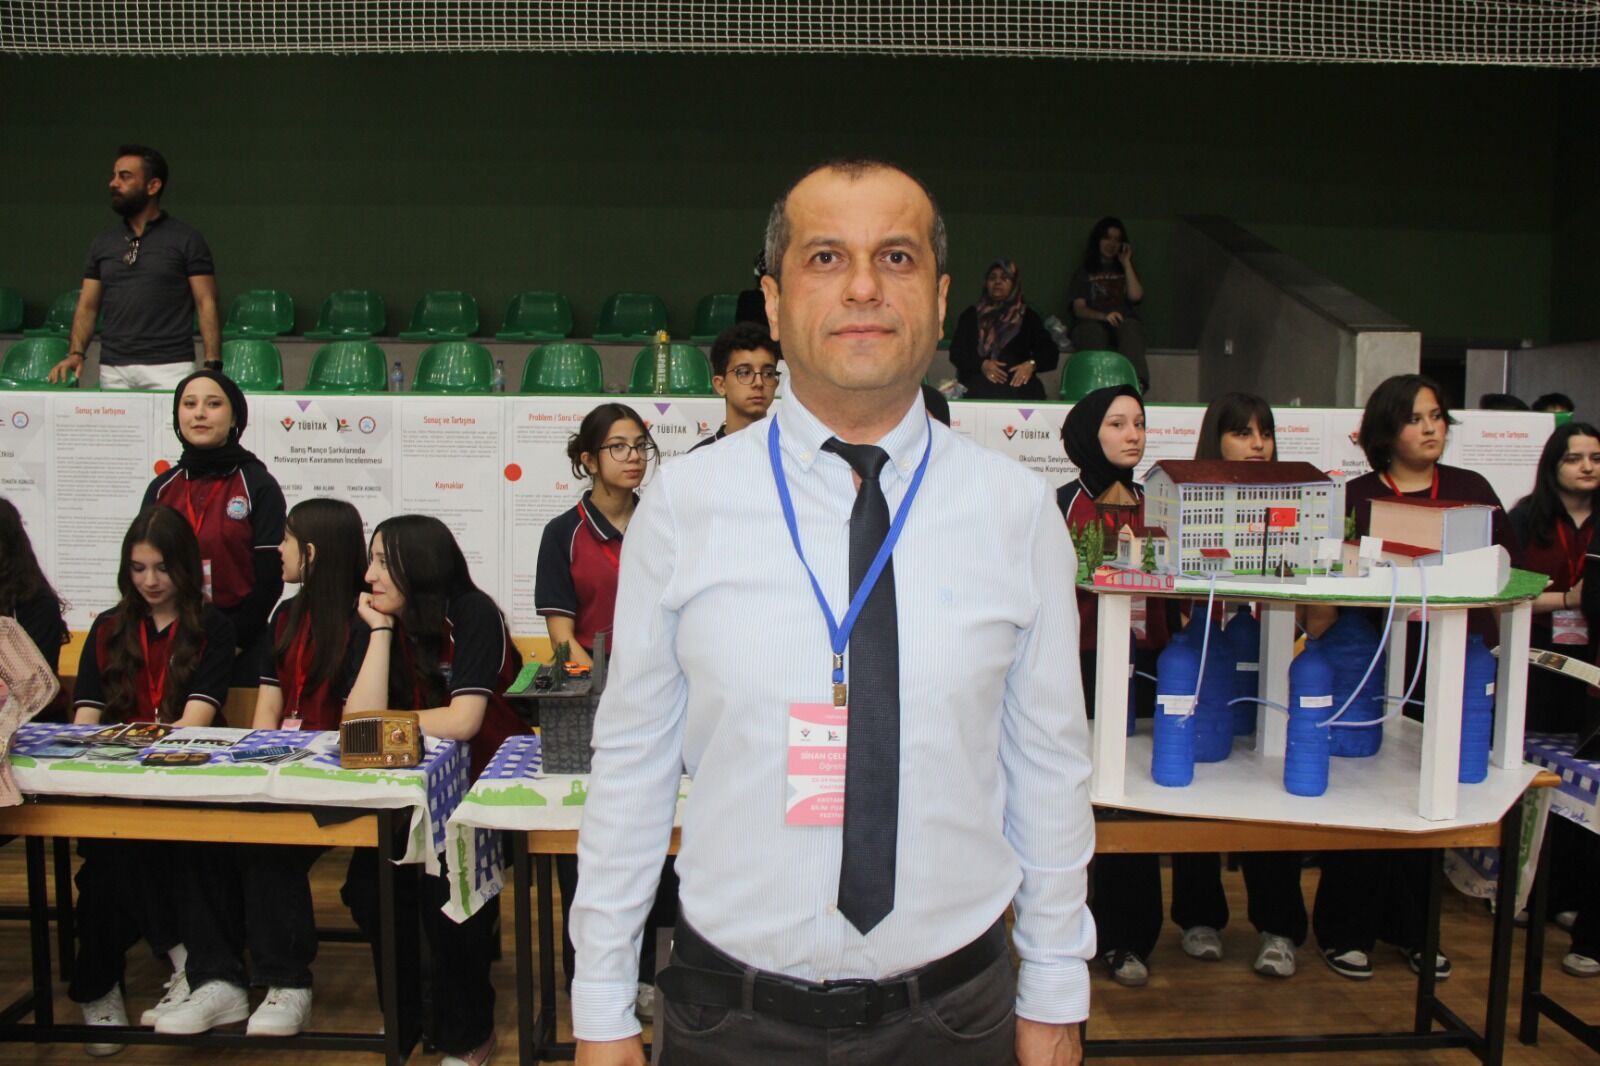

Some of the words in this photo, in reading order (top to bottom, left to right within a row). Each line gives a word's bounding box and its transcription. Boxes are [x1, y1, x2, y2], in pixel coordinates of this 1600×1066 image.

[423, 416, 442, 426] Sonuç
[451, 416, 476, 426] Tartışma
[528, 413, 553, 422] Problem
[557, 414, 572, 422] Soru
[298, 421, 328, 431] TÜBİTAK
[656, 424, 687, 434] TÜBİTAK
[1020, 428, 1050, 440] TÜBİTAK
[273, 456, 308, 466] Motivasyon
[435, 481, 464, 491] Kaynaklar
[555, 481, 569, 491] Özet
